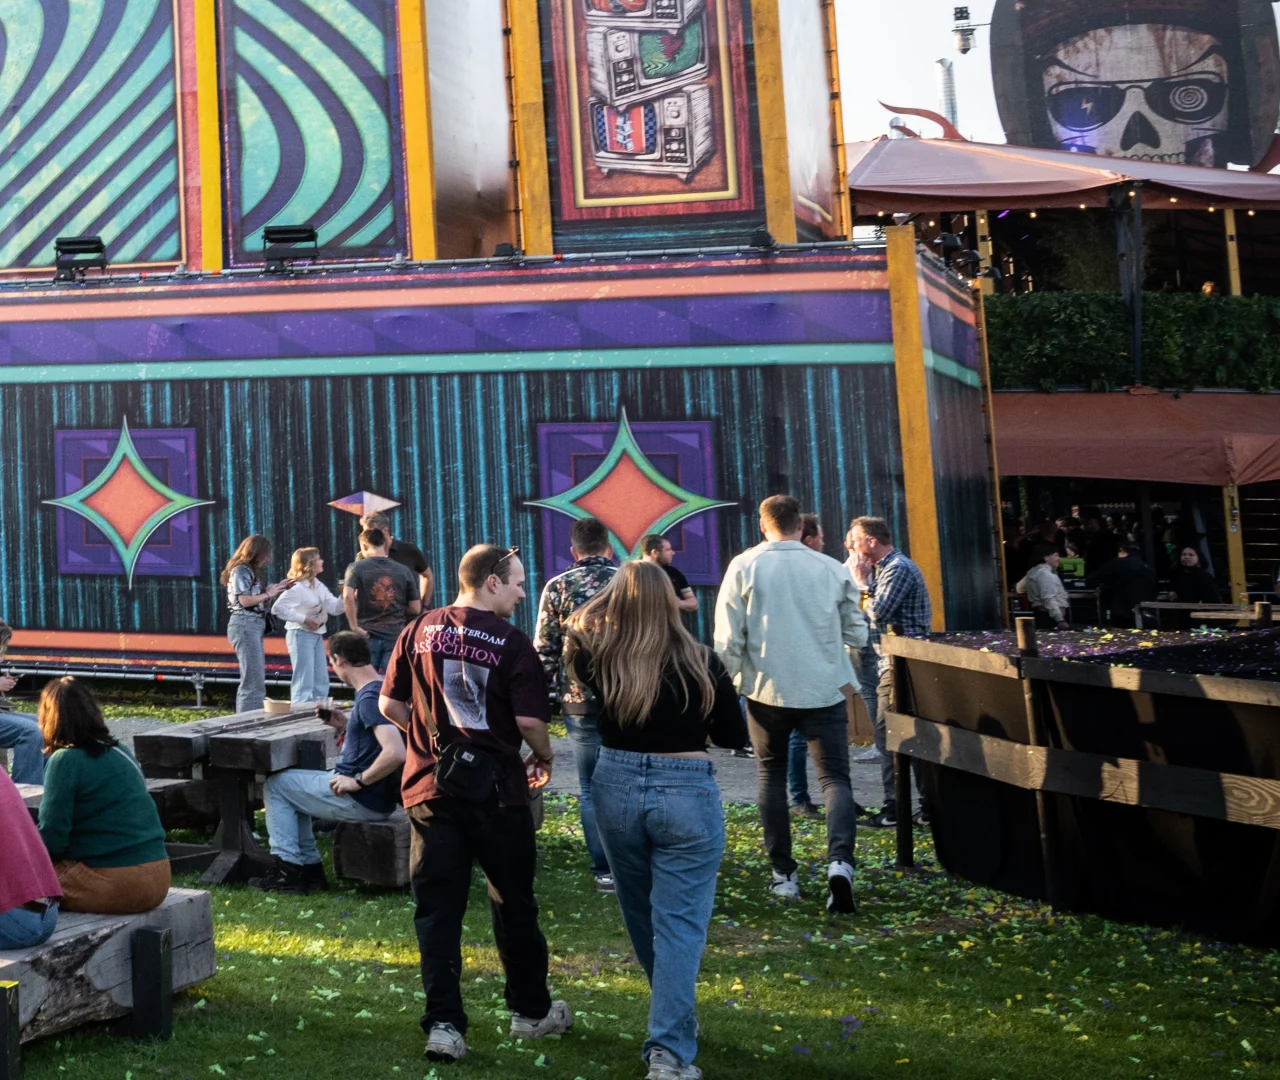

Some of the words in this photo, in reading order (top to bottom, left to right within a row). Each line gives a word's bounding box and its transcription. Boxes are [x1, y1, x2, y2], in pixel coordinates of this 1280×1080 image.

[423, 624, 445, 633] NEW
[446, 626, 506, 645] AMSTERDAM
[425, 631, 461, 645] SURF
